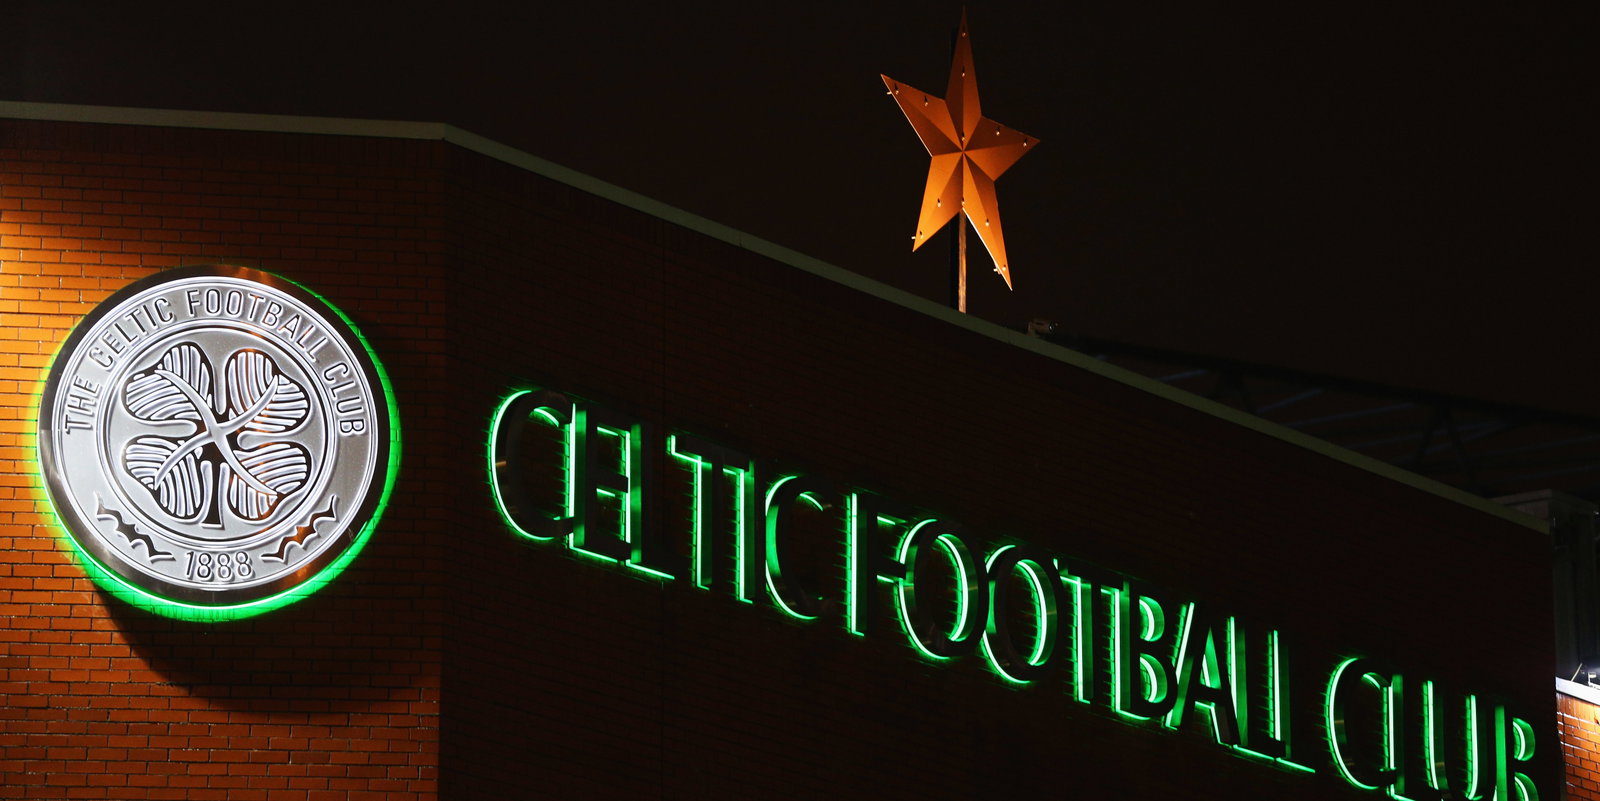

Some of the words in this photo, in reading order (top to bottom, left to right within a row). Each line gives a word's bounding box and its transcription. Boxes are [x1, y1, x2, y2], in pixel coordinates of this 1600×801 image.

[65, 372, 99, 435] THE
[88, 297, 174, 370] CELTIC
[185, 287, 328, 363] FOOTBALL
[323, 361, 366, 436] CLUB
[184, 550, 255, 582] 1888
[487, 386, 838, 622] CELTIC
[844, 489, 1316, 774] FOOTBALL
[1323, 655, 1543, 801] CLUB
